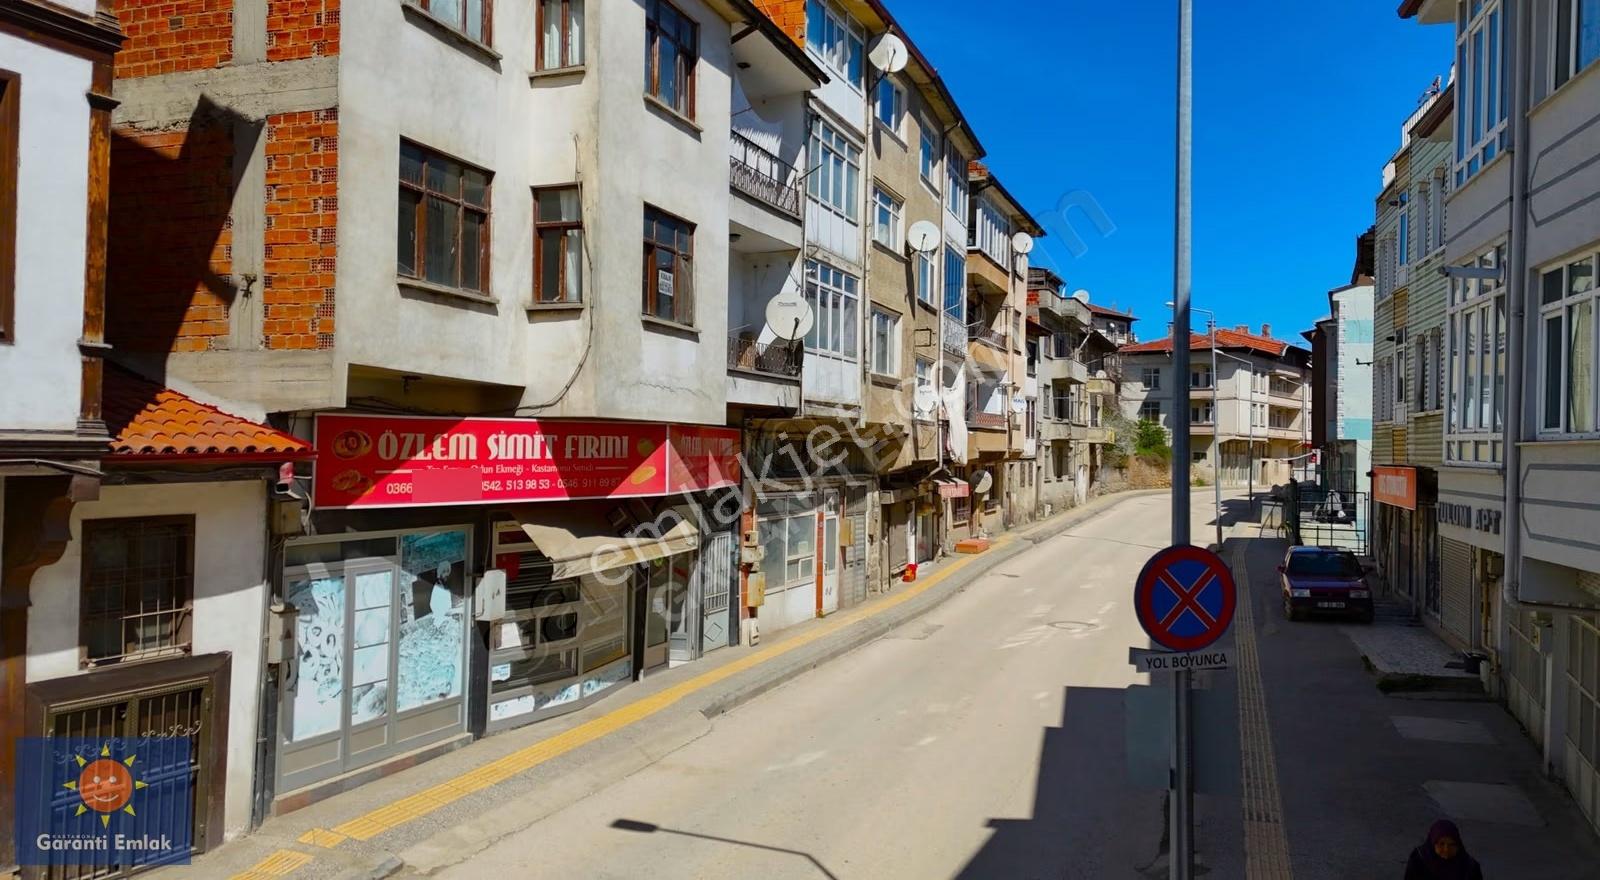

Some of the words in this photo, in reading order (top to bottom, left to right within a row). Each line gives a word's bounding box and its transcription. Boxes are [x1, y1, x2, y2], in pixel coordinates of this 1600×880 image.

[377, 430, 477, 461] ÖZLEM
[486, 431, 558, 460] SİMİT
[565, 435, 629, 459] FIRINI
[386, 482, 413, 495] 0366
[506, 479, 523, 490] 513
[525, 479, 537, 490] 98
[538, 479, 550, 489] 53
[557, 478, 578, 488] 0546
[1145, 657, 1169, 669] YOL
[1172, 653, 1228, 668] BOYUNCA
